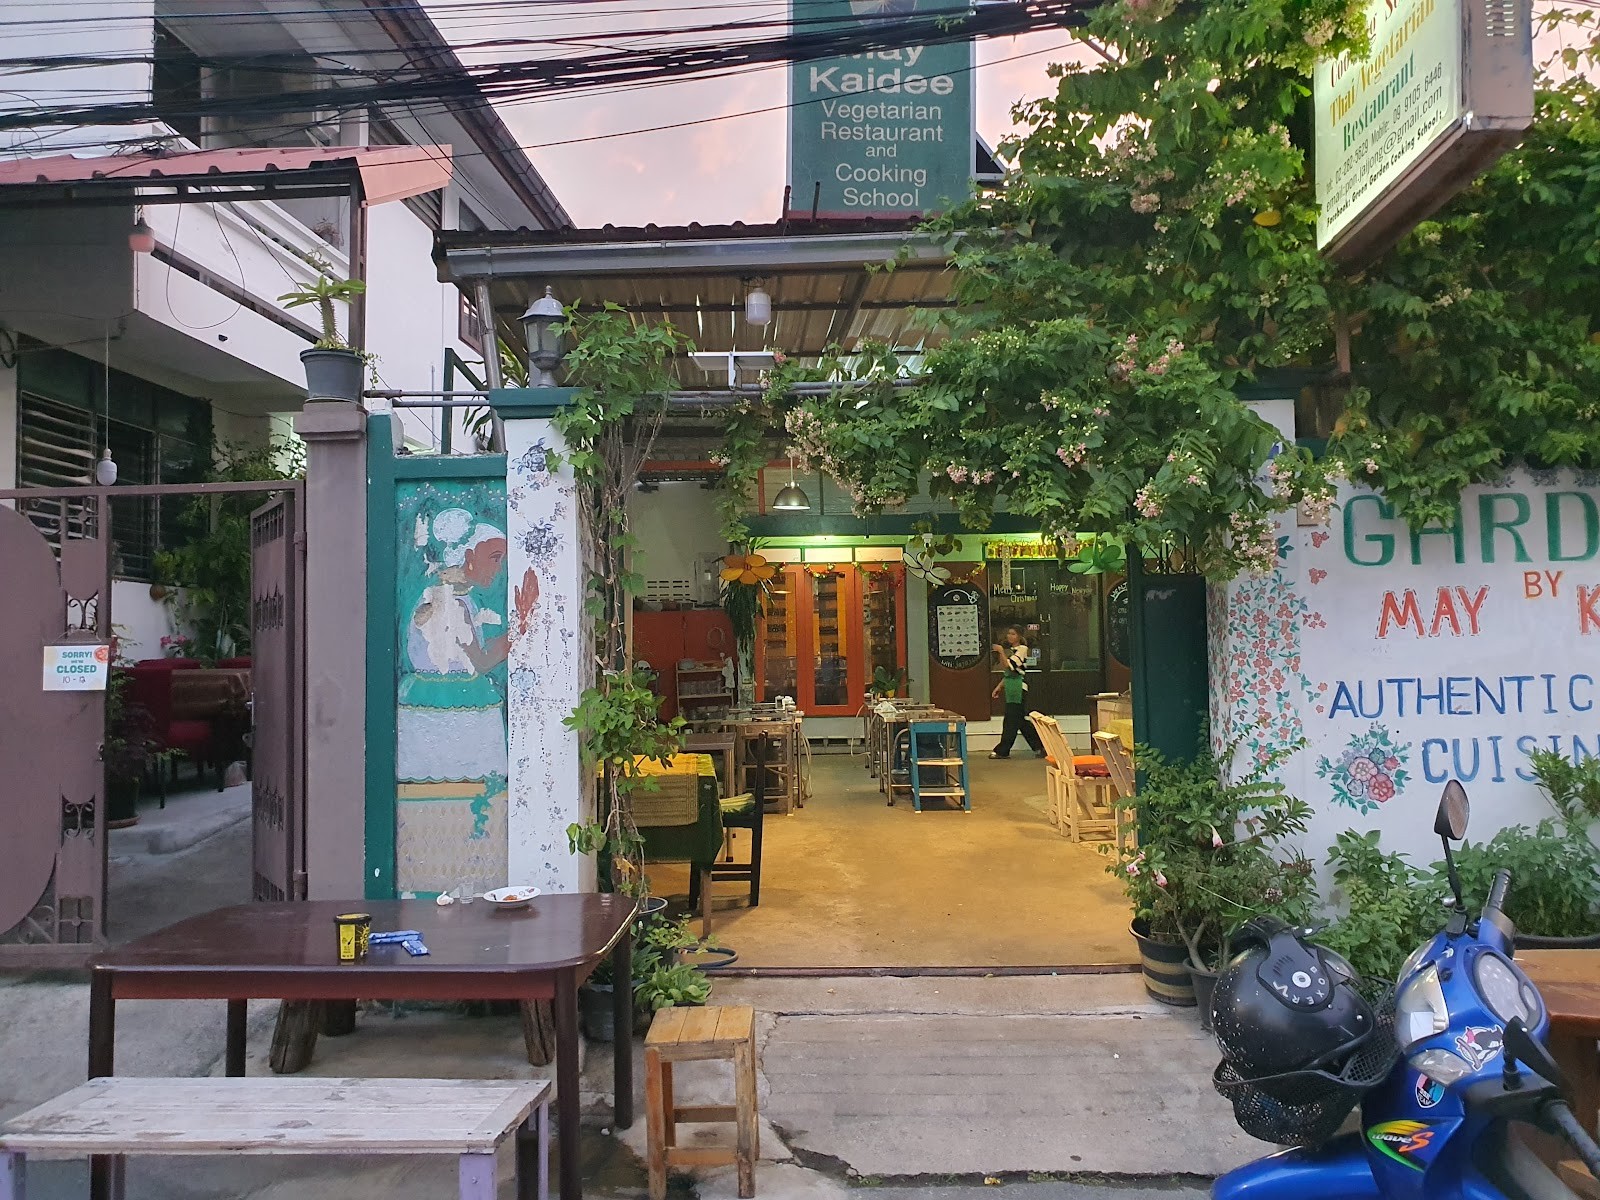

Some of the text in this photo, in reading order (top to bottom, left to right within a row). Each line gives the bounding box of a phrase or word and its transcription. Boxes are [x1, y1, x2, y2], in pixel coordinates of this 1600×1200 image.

[809, 67, 954, 95] Kaidee
[1404, 83, 1421, 112] 9105
[1424, 61, 1442, 92] 6446
[821, 100, 942, 123] Vegetarian
[1343, 48, 1414, 152] Restaurant
[821, 121, 943, 142] Restaurant
[865, 143, 897, 158] and
[835, 163, 927, 188] Cooking
[1351, 182, 1368, 202] Green
[1369, 161, 1390, 186] Garden
[1390, 136, 1415, 166] Cooking
[842, 188, 919, 207] School
[1524, 570, 1563, 600] BY
[1375, 585, 1490, 639] MAY
[57, 665, 97, 673] CLOSED
[1329, 674, 1593, 719] AUTHENTIC
